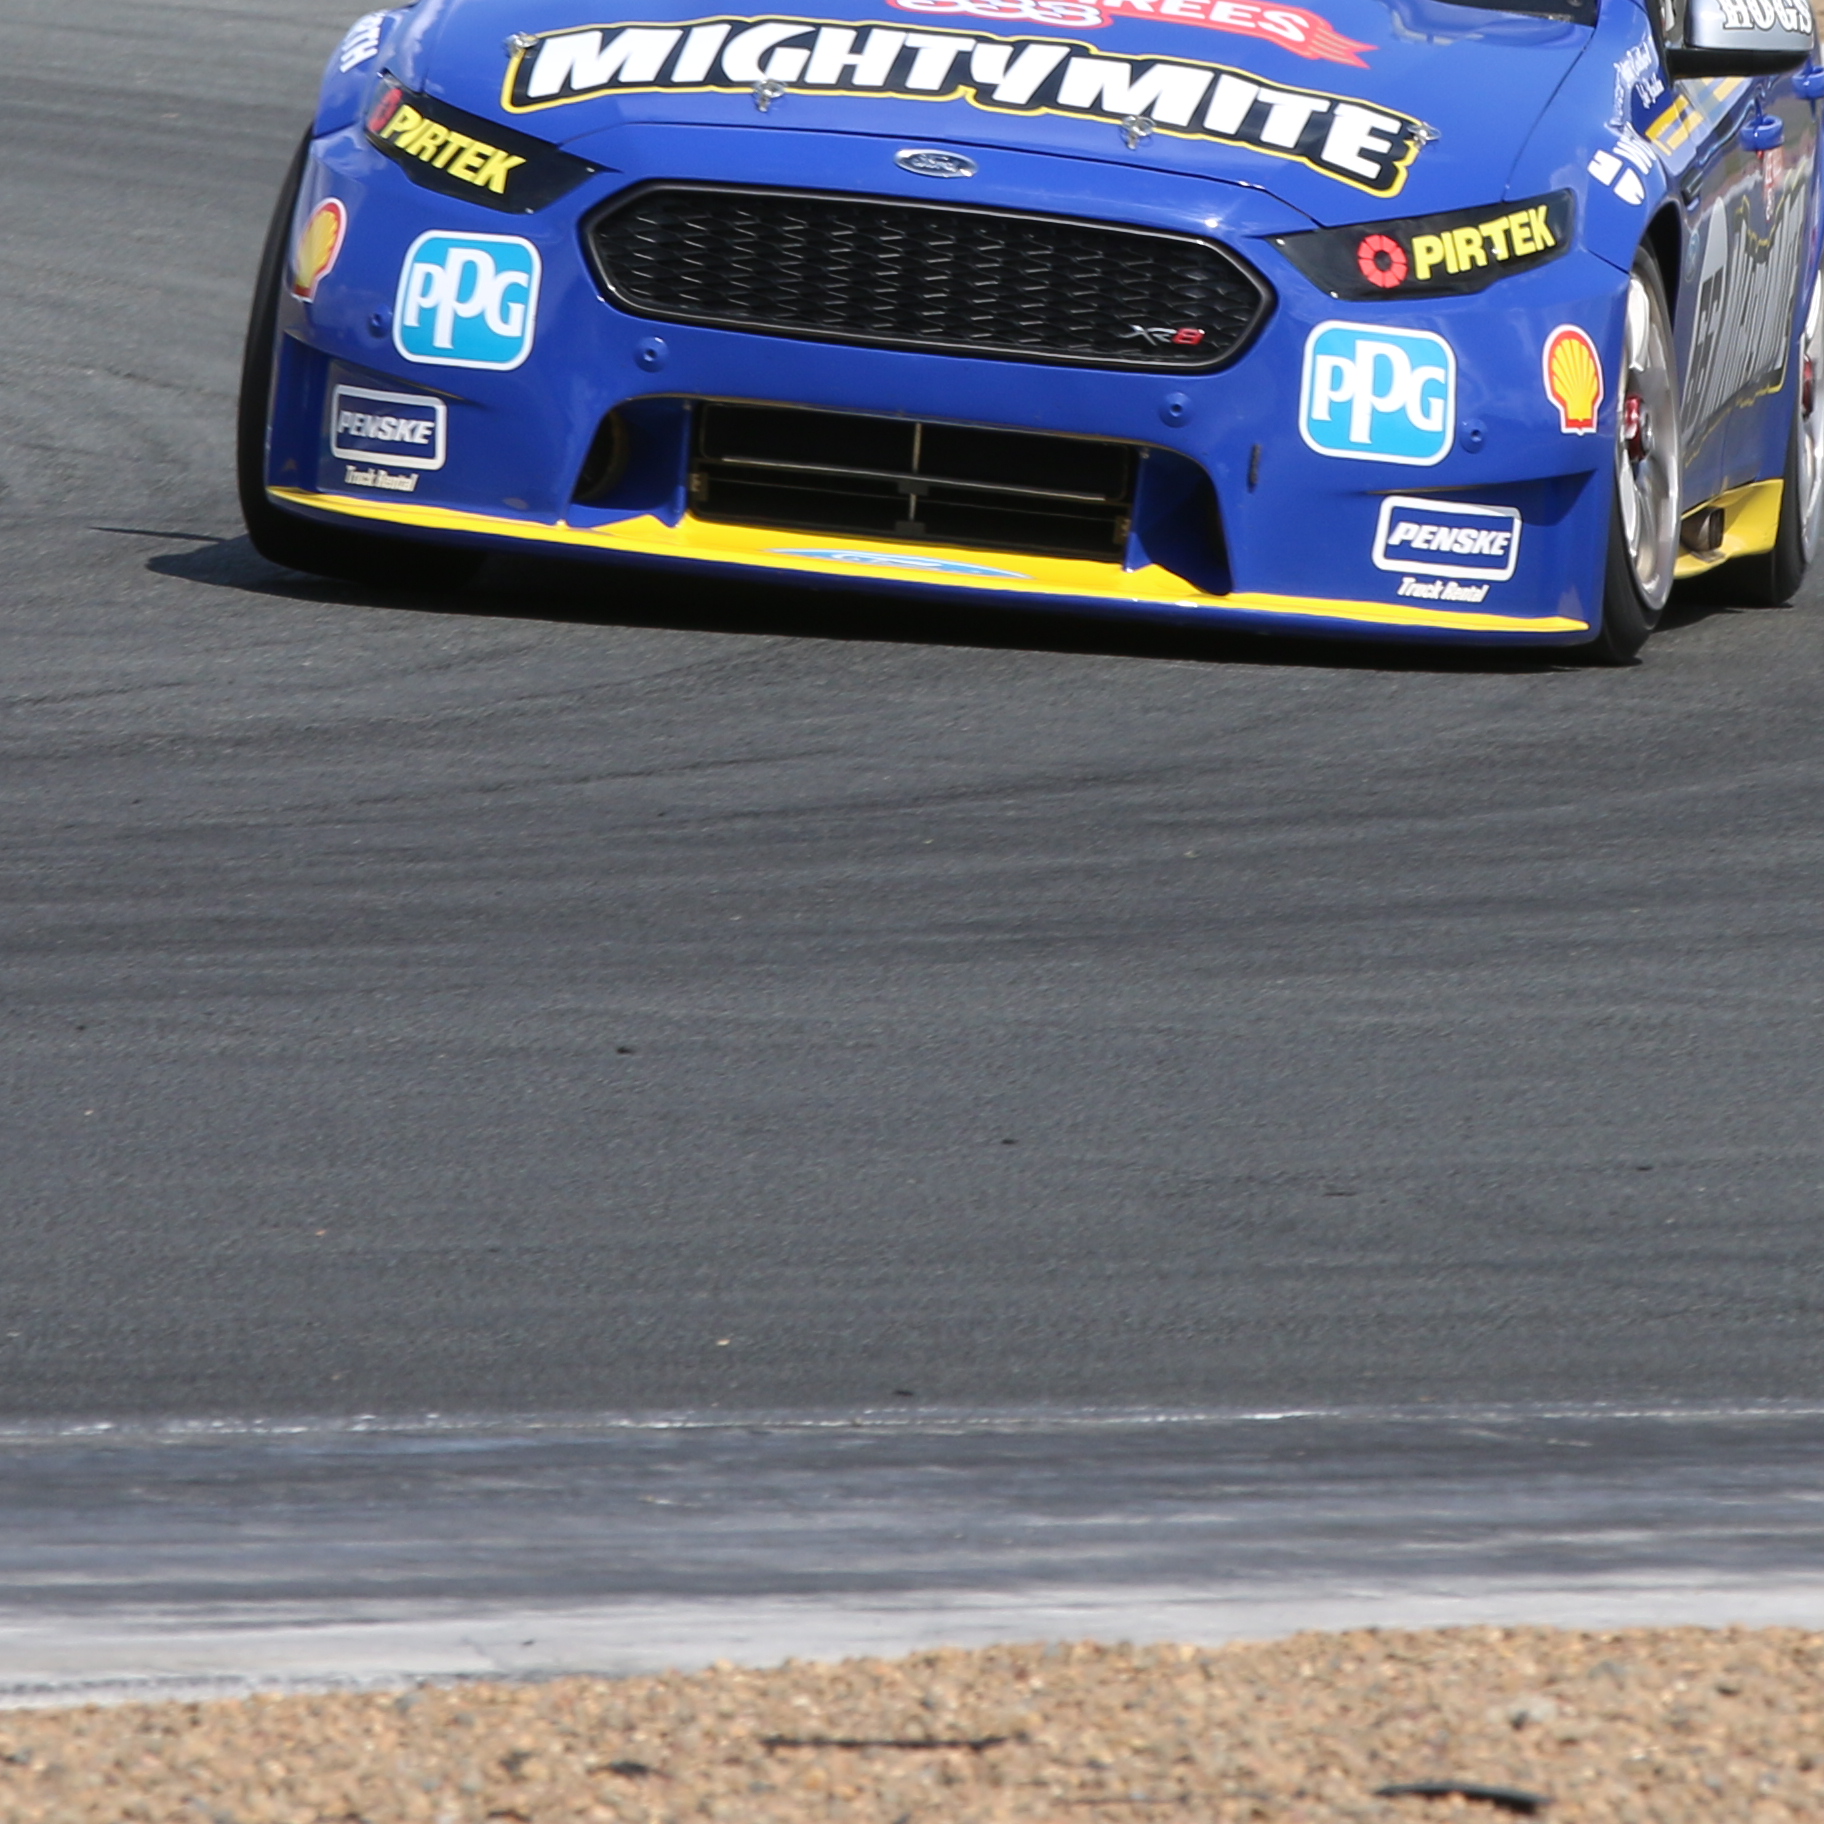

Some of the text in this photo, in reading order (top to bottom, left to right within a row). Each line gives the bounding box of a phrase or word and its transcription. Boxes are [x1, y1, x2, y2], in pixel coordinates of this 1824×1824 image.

[380, 102, 526, 194] PIRTEK
[1411, 204, 1557, 281] PIRTEK
[402, 247, 530, 350] PPG
[337, 409, 435, 444] PENSKE
[1310, 338, 1447, 445] PPG
[1387, 520, 1512, 556] PENSKE
[1397, 576, 1490, 603] Truck Rental
